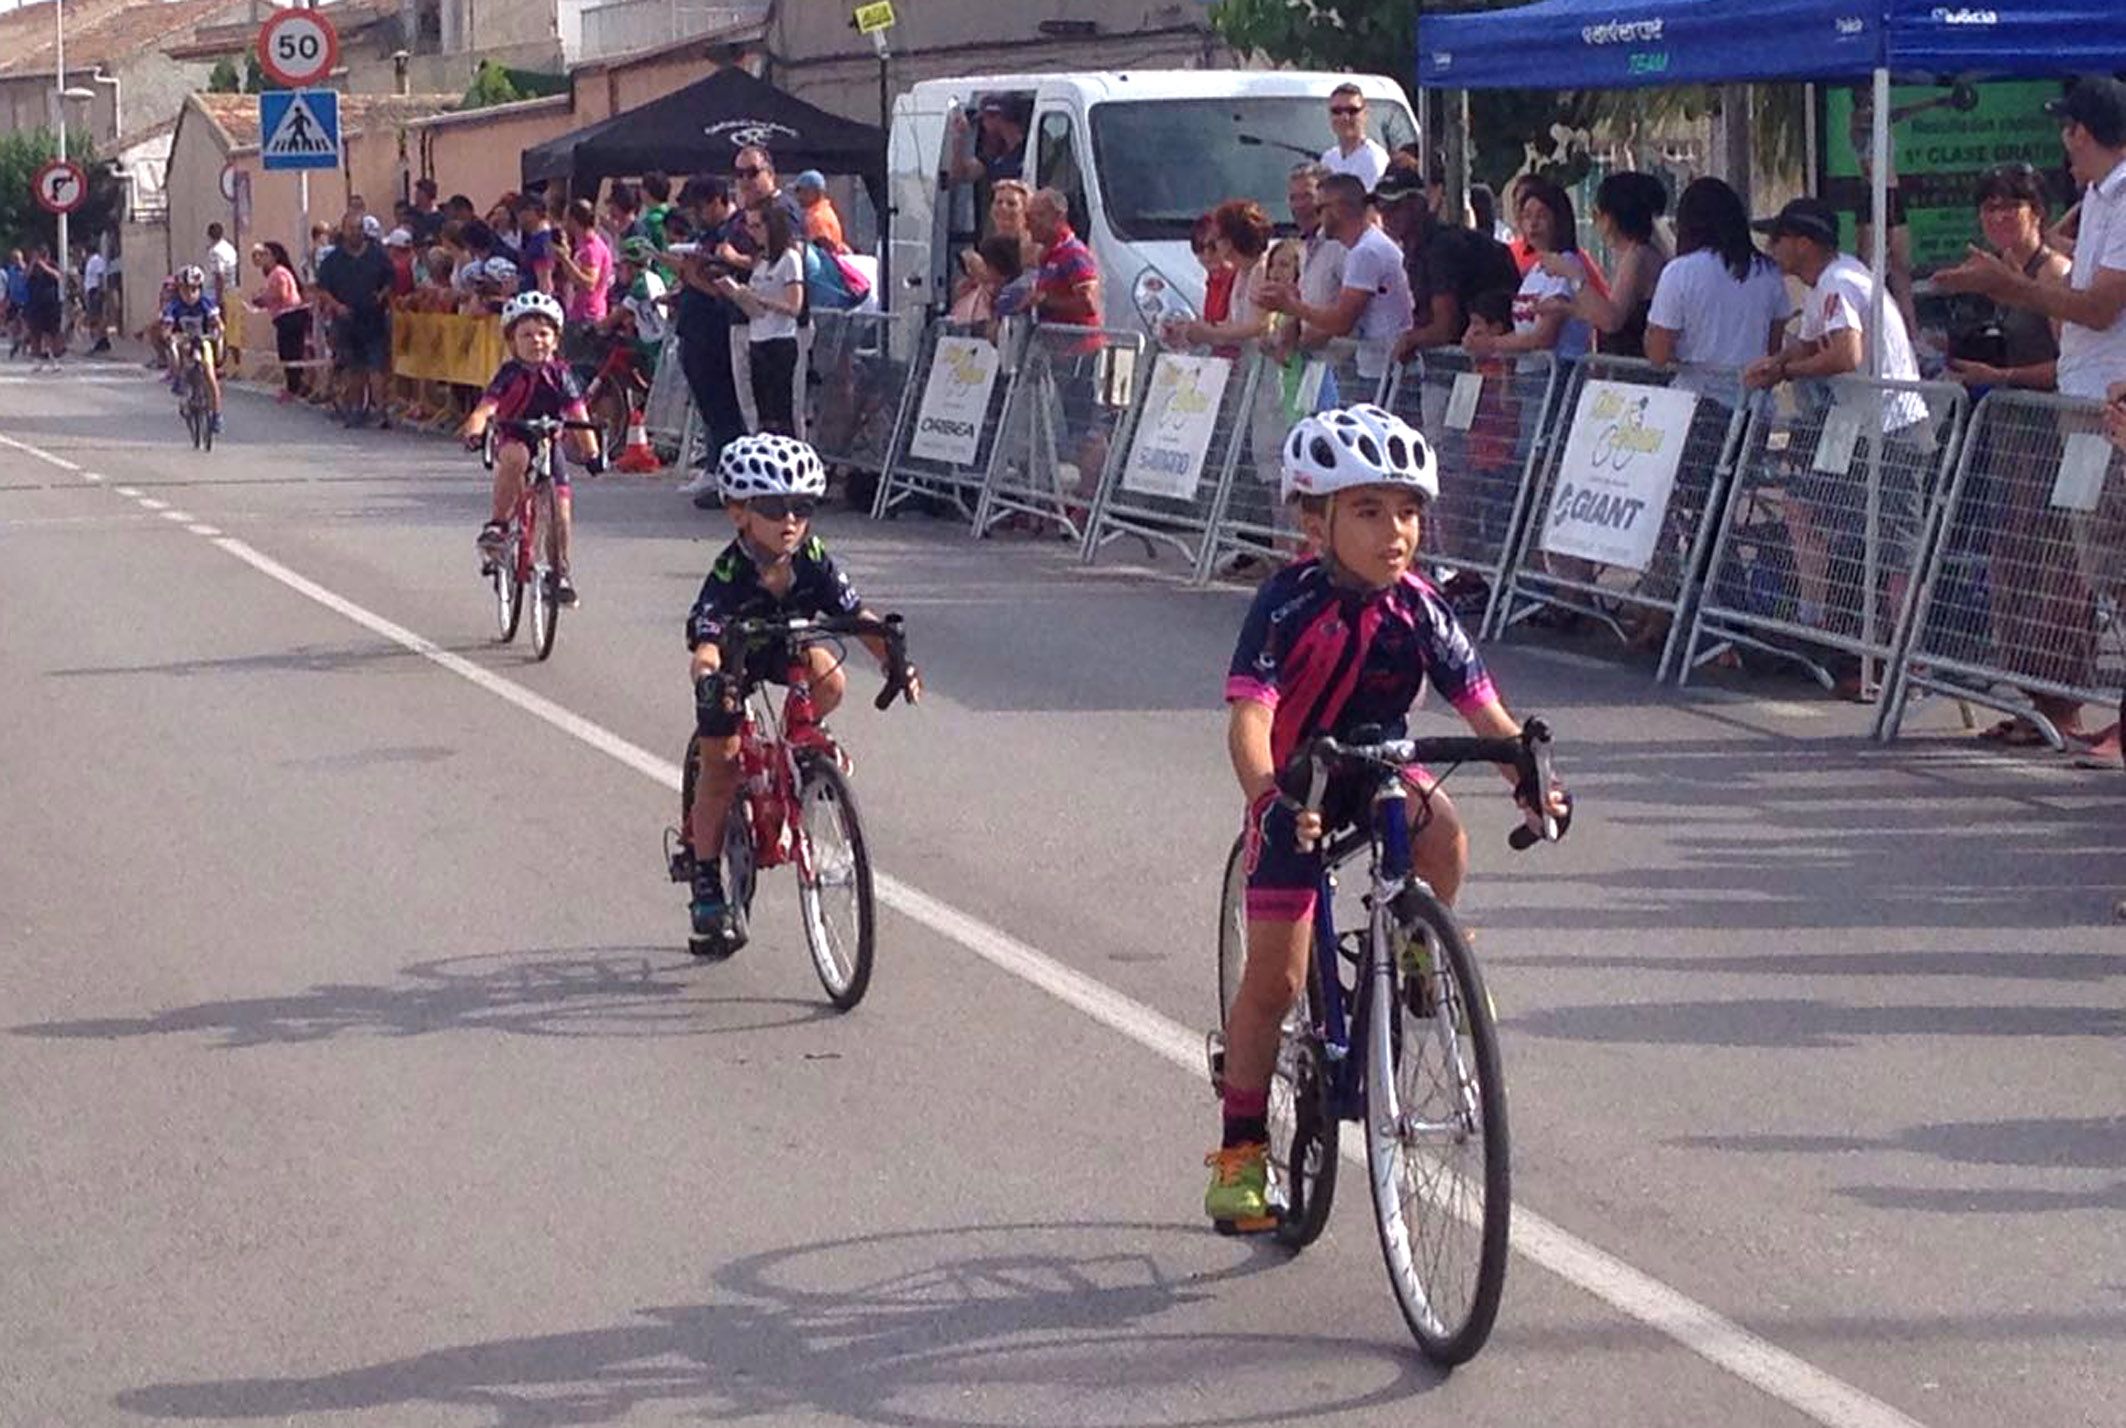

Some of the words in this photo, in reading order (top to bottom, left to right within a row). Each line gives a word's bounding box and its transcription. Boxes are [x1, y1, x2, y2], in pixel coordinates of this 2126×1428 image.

[279, 34, 318, 59] 50
[1927, 145, 1987, 165] CLASE
[1570, 489, 1645, 530] GIANT
